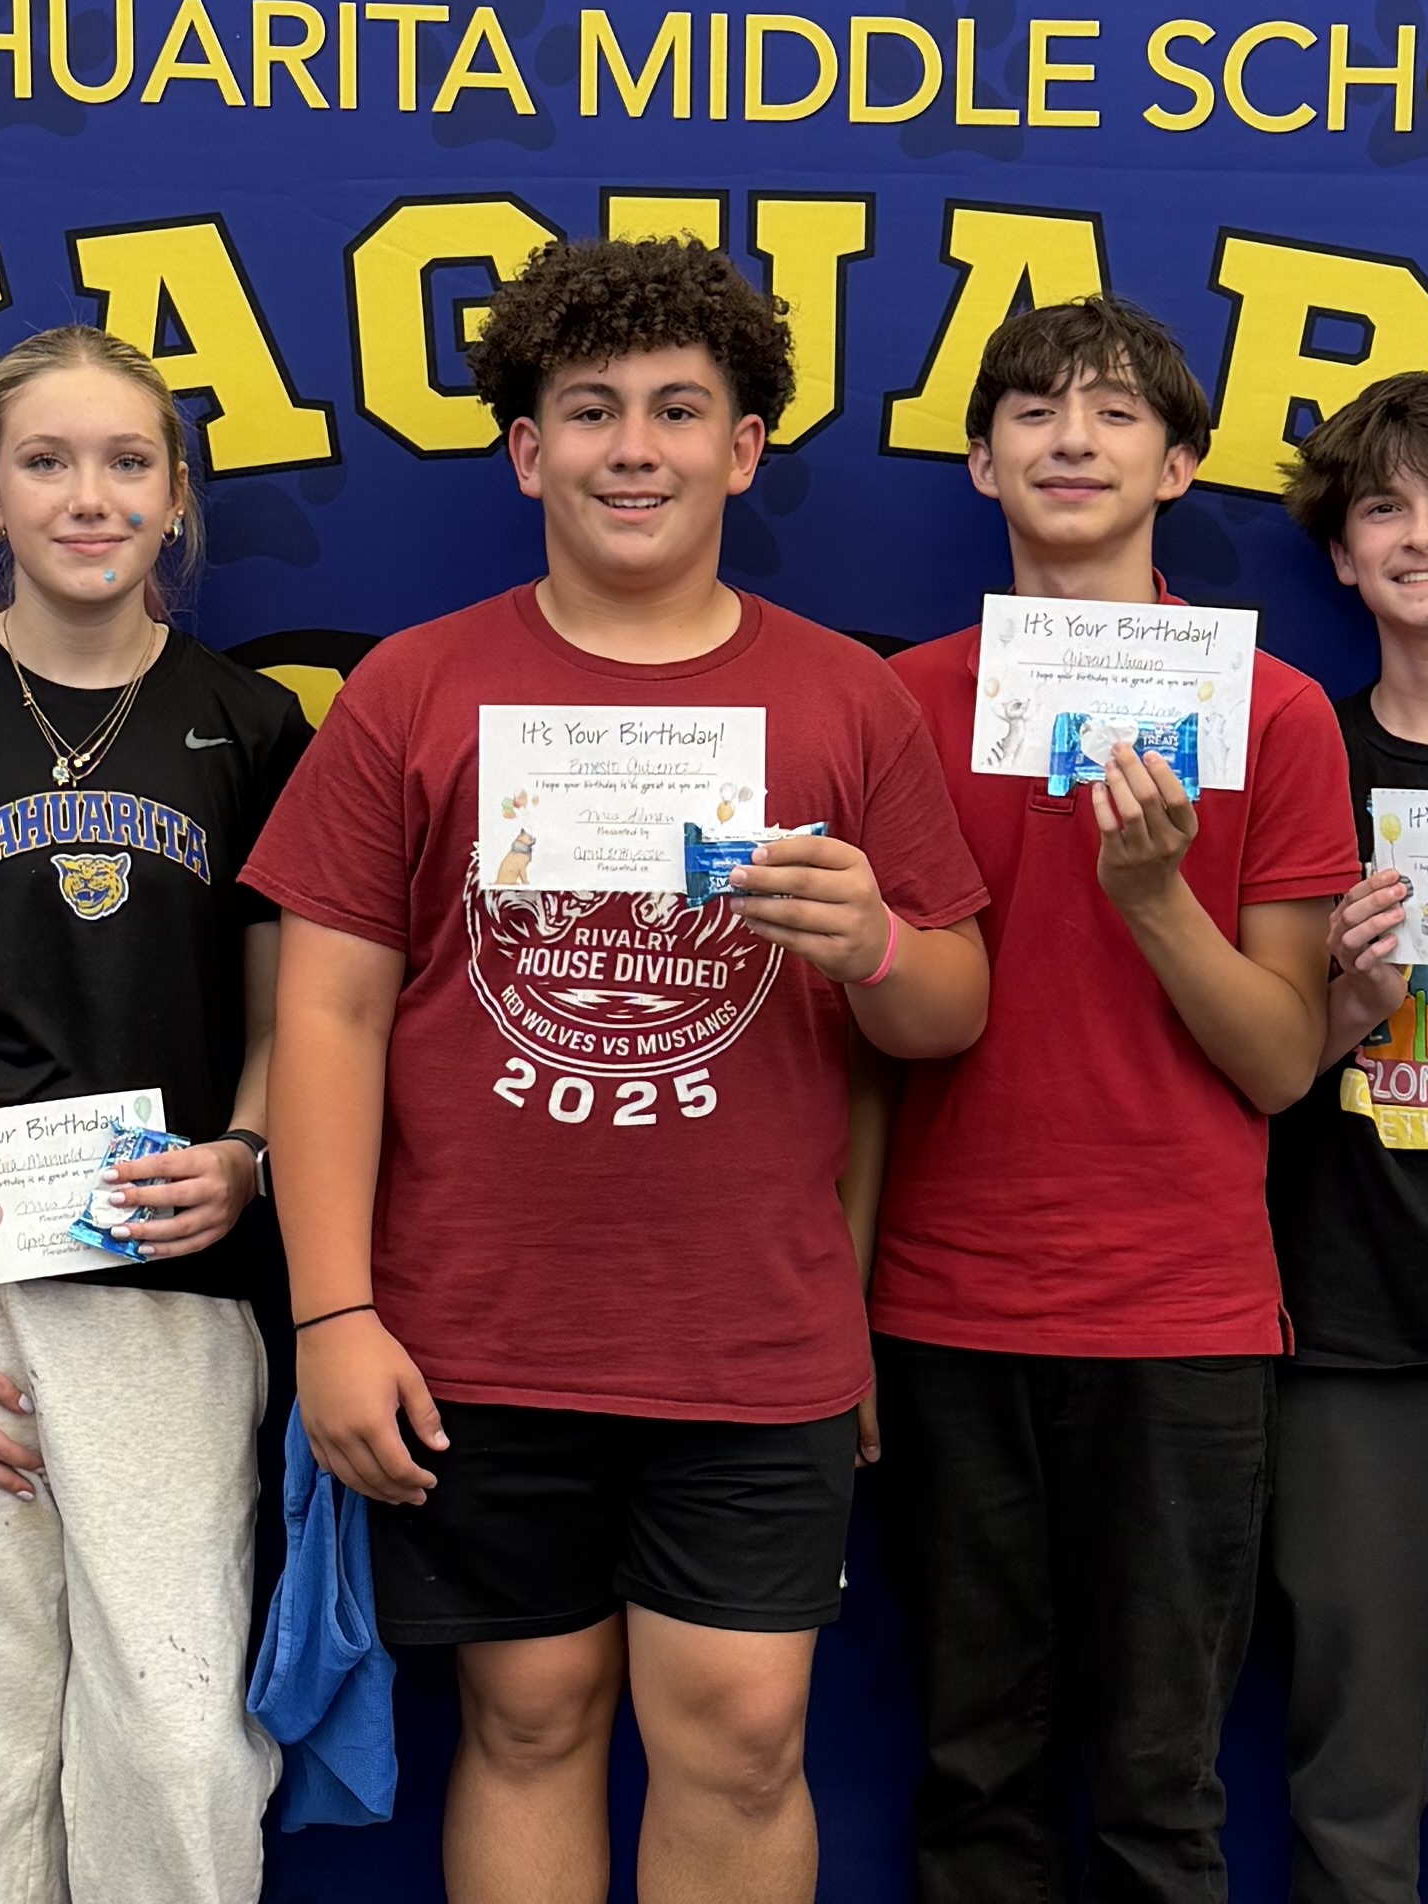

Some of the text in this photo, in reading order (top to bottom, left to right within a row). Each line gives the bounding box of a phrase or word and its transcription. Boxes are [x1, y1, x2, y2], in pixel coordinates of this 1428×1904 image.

[580, 9, 1101, 128] MIDDLE
[1024, 613, 1219, 656] It's Your Birthday!
[1076, 671, 1108, 685] birthday
[1132, 676, 1153, 688] great
[522, 721, 725, 758] It's Your Birthday!
[584, 780, 617, 791] birthday
[641, 782, 664, 794] great
[575, 928, 679, 953] RIVALRY
[517, 949, 729, 990] HOUSE DIVIDED
[501, 985, 739, 1056] RED WOLVES VS MUSTANGS
[492, 1056, 718, 1127] 2025
